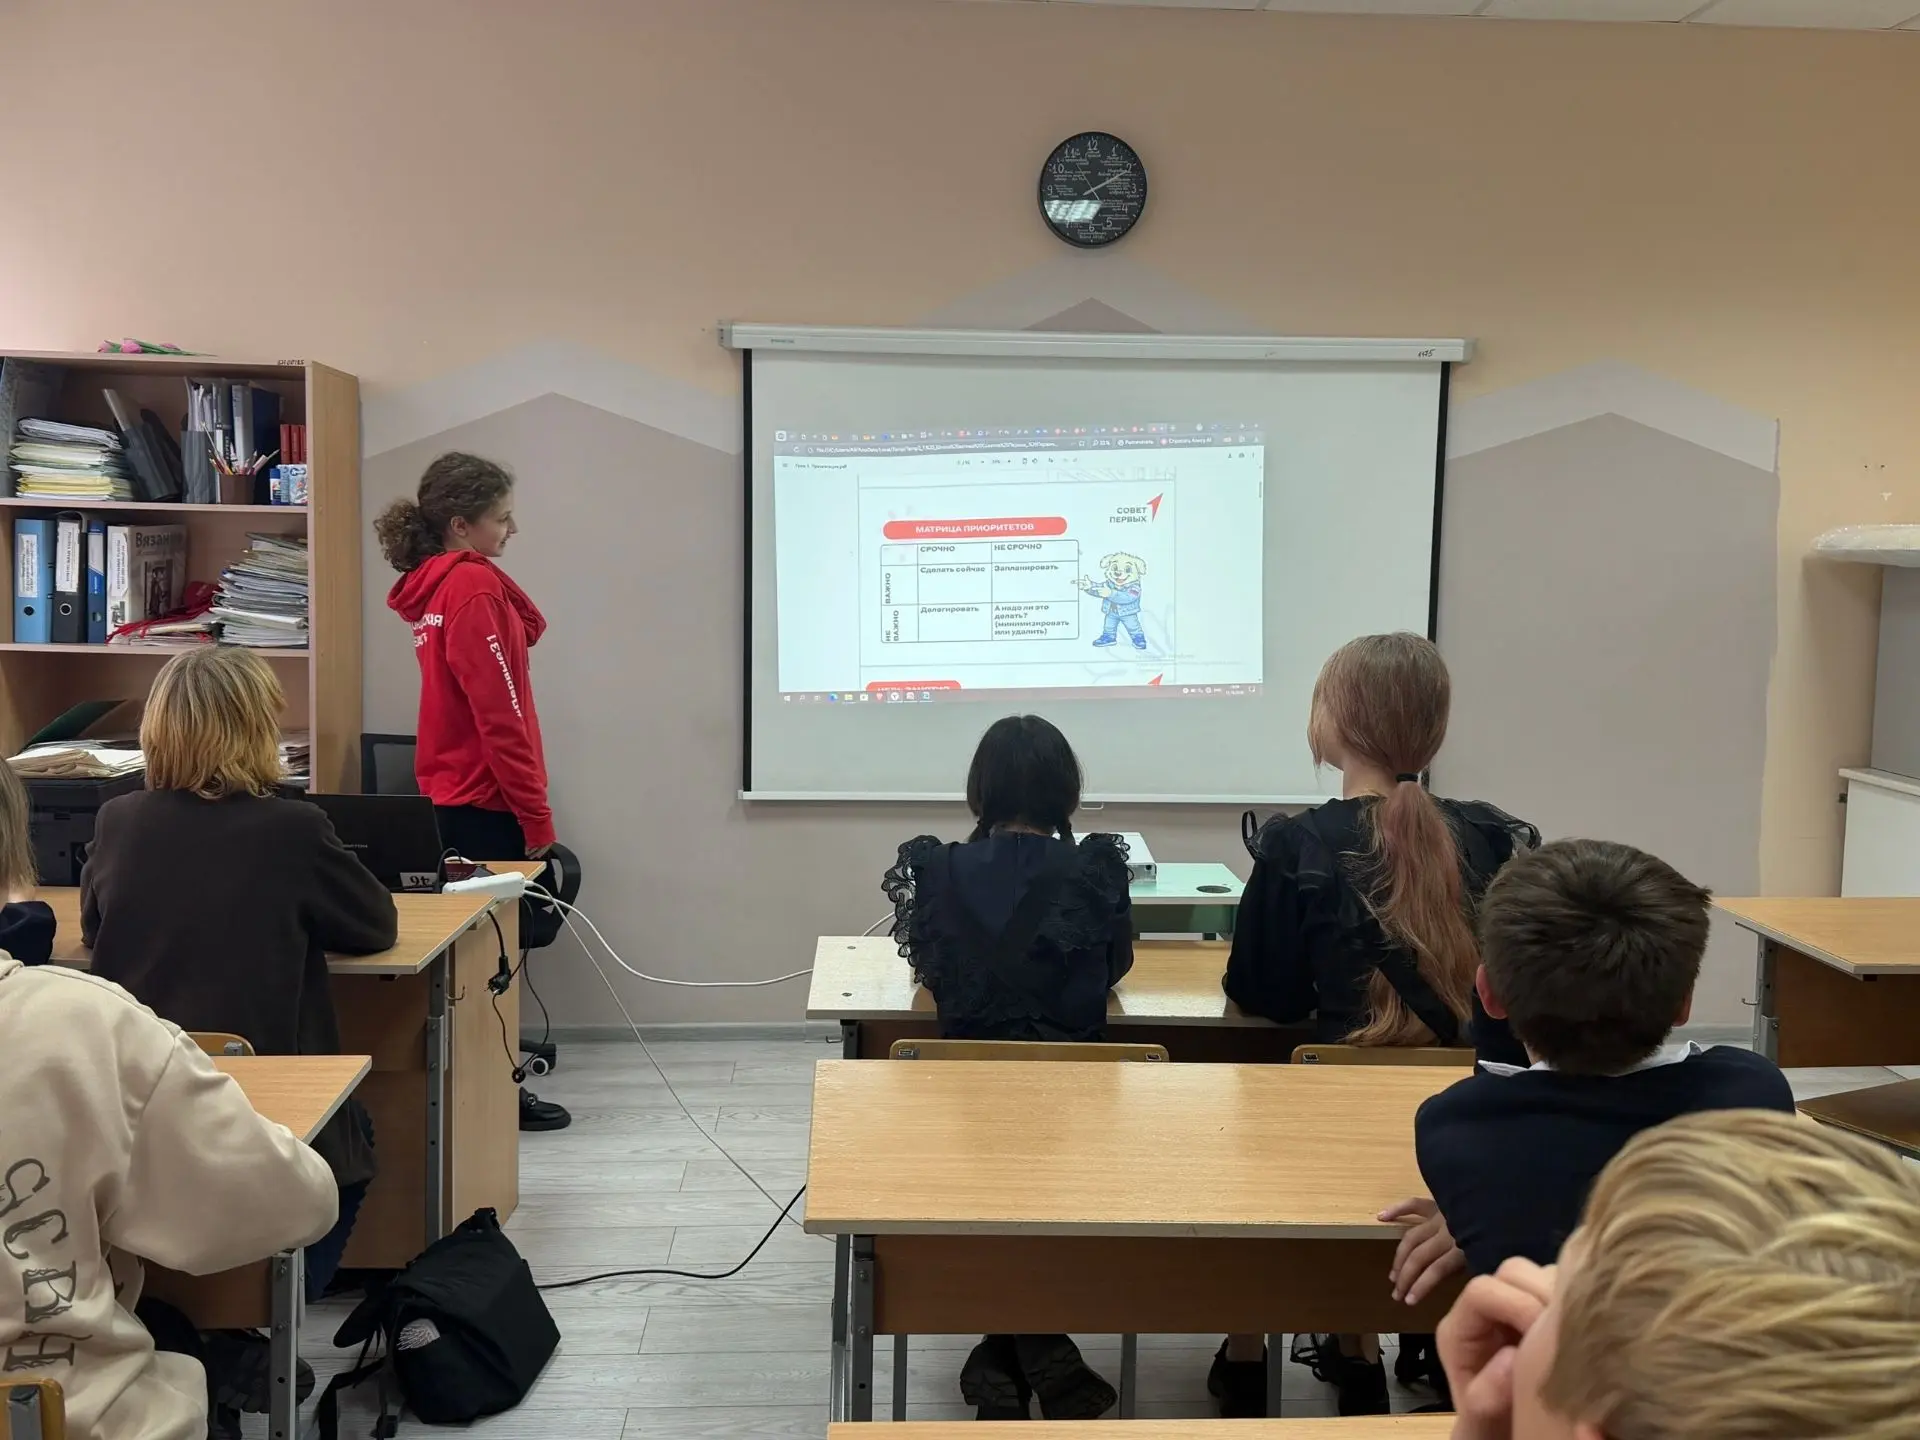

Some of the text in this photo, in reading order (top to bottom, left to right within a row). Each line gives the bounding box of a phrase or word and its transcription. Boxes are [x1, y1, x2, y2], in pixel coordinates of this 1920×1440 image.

[1109, 515, 1147, 523] ПЕРВЫХ
[915, 523, 1035, 534] МАТРИЦА ПРИОРИТЕТОВ
[920, 545, 956, 553] СРОЧНО
[1006, 543, 1043, 551] СРОЧНО
[920, 565, 985, 574] Сделать сейчас
[994, 564, 1059, 573] Запланировать
[920, 605, 980, 615] Делегировать
[994, 612, 1028, 620] делать?
[994, 620, 1070, 628] (минимизировать
[885, 630, 892, 642] НЕ
[1011, 628, 1048, 637] удалить)
